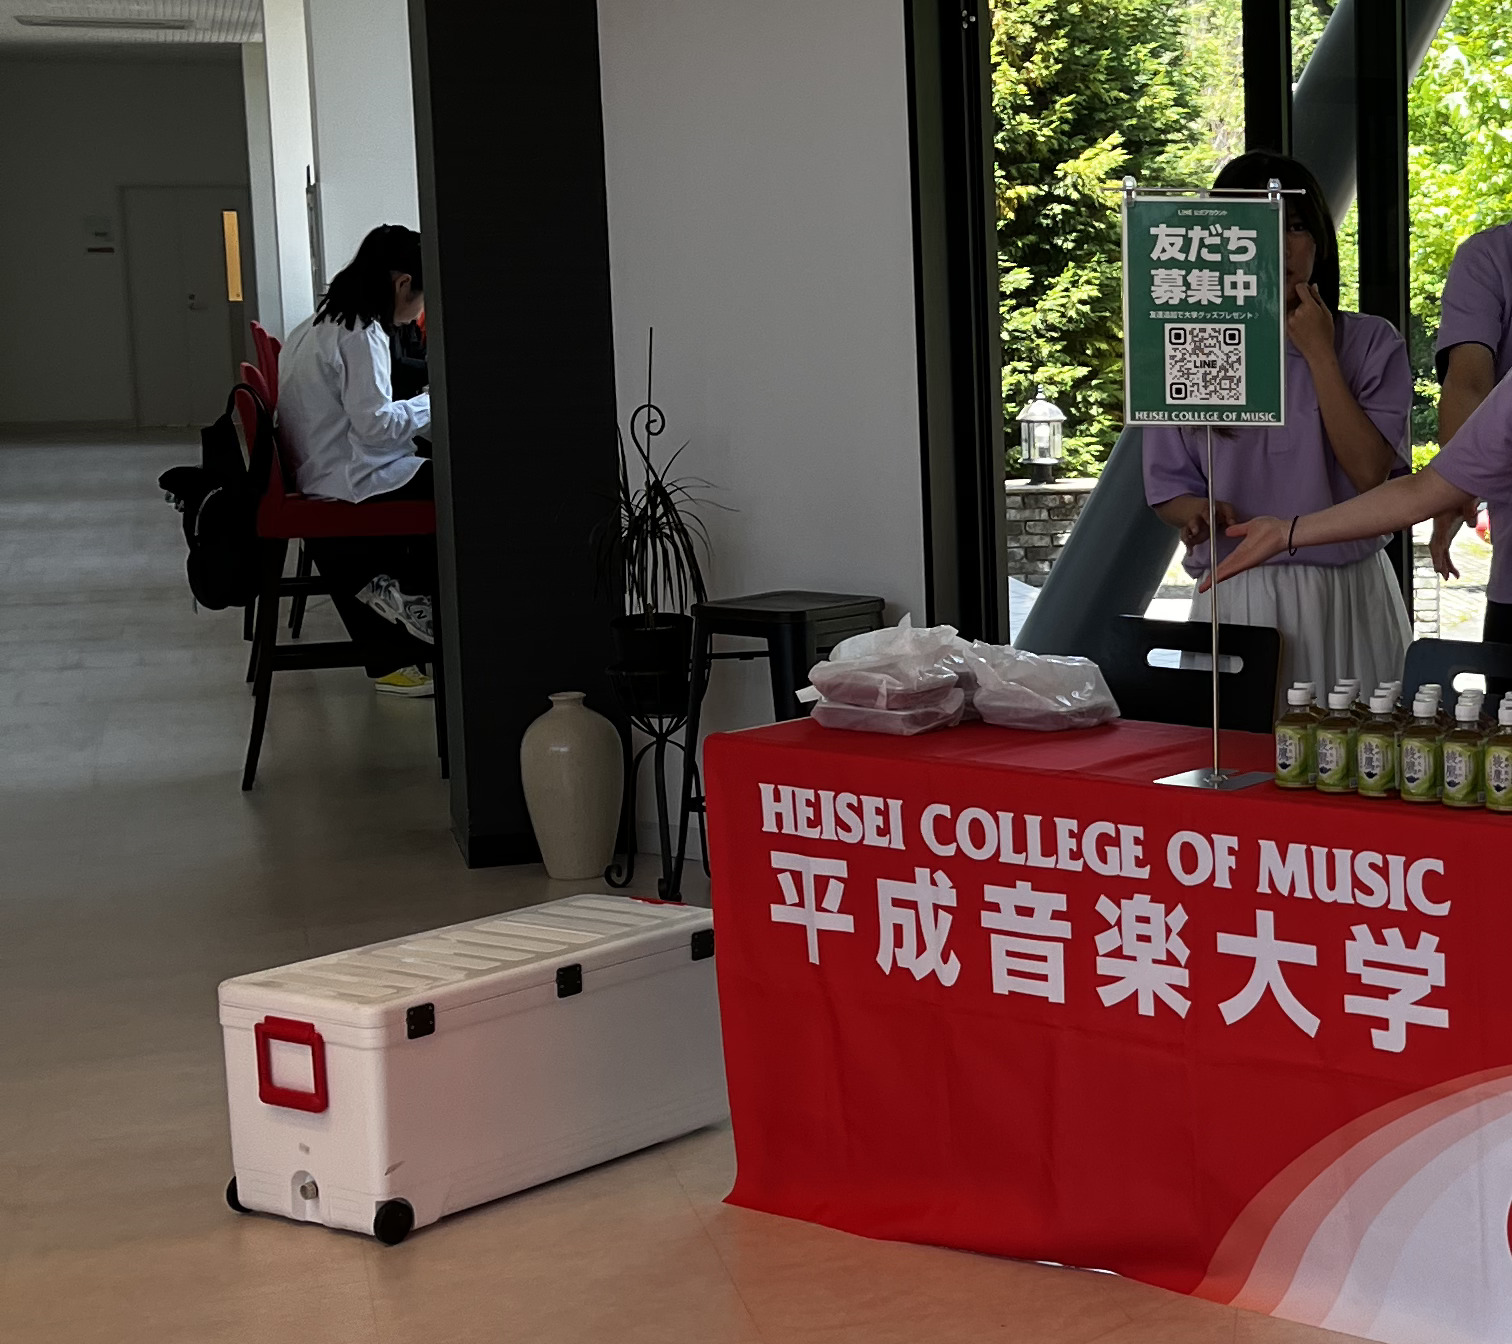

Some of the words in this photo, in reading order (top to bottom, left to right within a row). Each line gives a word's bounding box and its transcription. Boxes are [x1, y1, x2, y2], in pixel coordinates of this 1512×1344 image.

[1149, 223, 1257, 262] 友だち
[1150, 268, 1258, 306] 募集中
[1193, 359, 1218, 369] LINE
[1135, 411, 1169, 421] HEISEI
[1171, 411, 1220, 421] COLLEGE
[1222, 411, 1238, 421] OF
[1240, 412, 1277, 422] MUSIC
[757, 782, 906, 851] HEISEI
[920, 803, 1150, 881] COLLEGE
[1166, 830, 1239, 890] OF
[1256, 839, 1452, 917] MUSIC
[769, 849, 1450, 1054] 平成音楽大学
